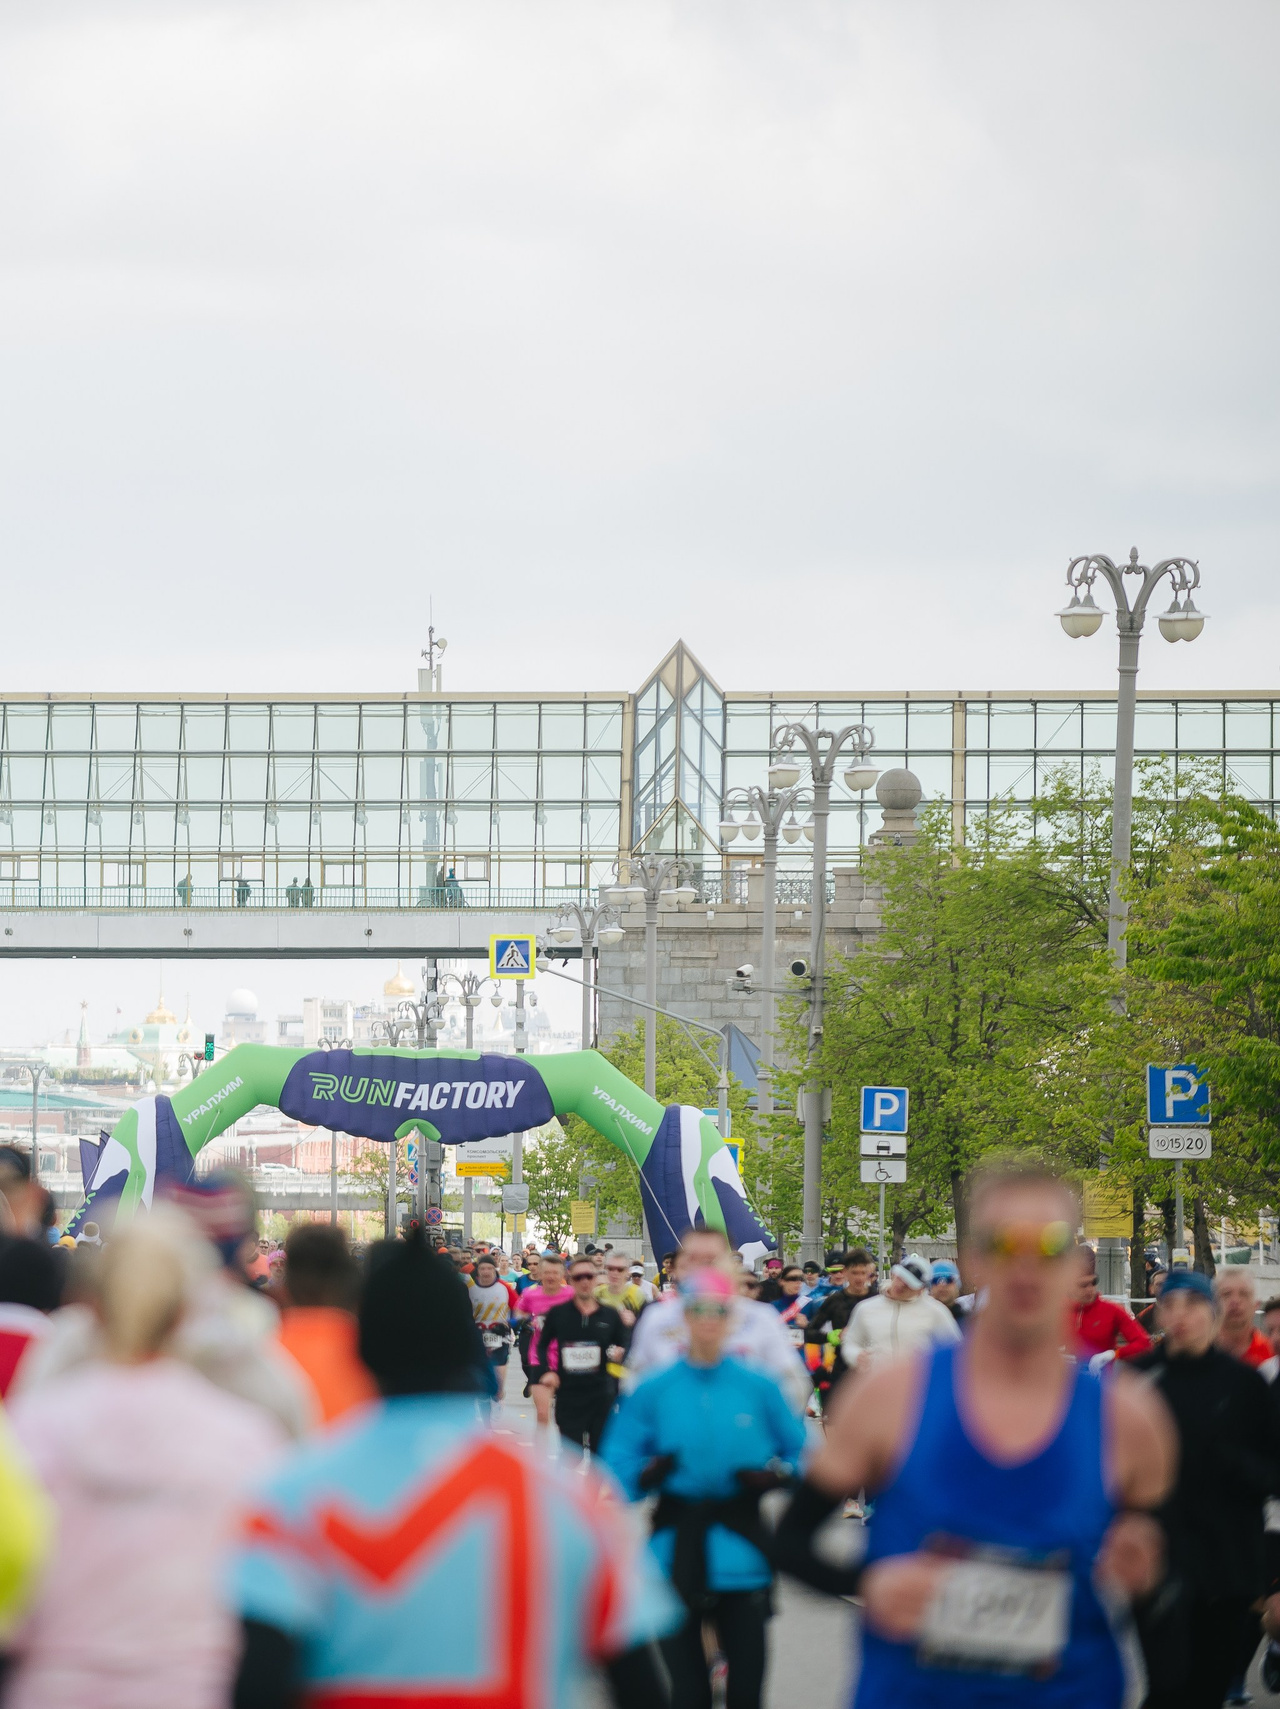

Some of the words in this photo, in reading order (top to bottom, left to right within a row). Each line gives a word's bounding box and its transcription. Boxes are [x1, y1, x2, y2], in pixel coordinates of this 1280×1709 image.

[182, 1075, 244, 1125] УРАЛХИМ
[592, 1085, 653, 1135] УРАЛХИМ
[873, 1092, 900, 1127] P
[1165, 1070, 1199, 1118] P
[1156, 1139, 1166, 1147] 10
[1169, 1138, 1181, 1149] 15
[1186, 1137, 1204, 1150] 20
